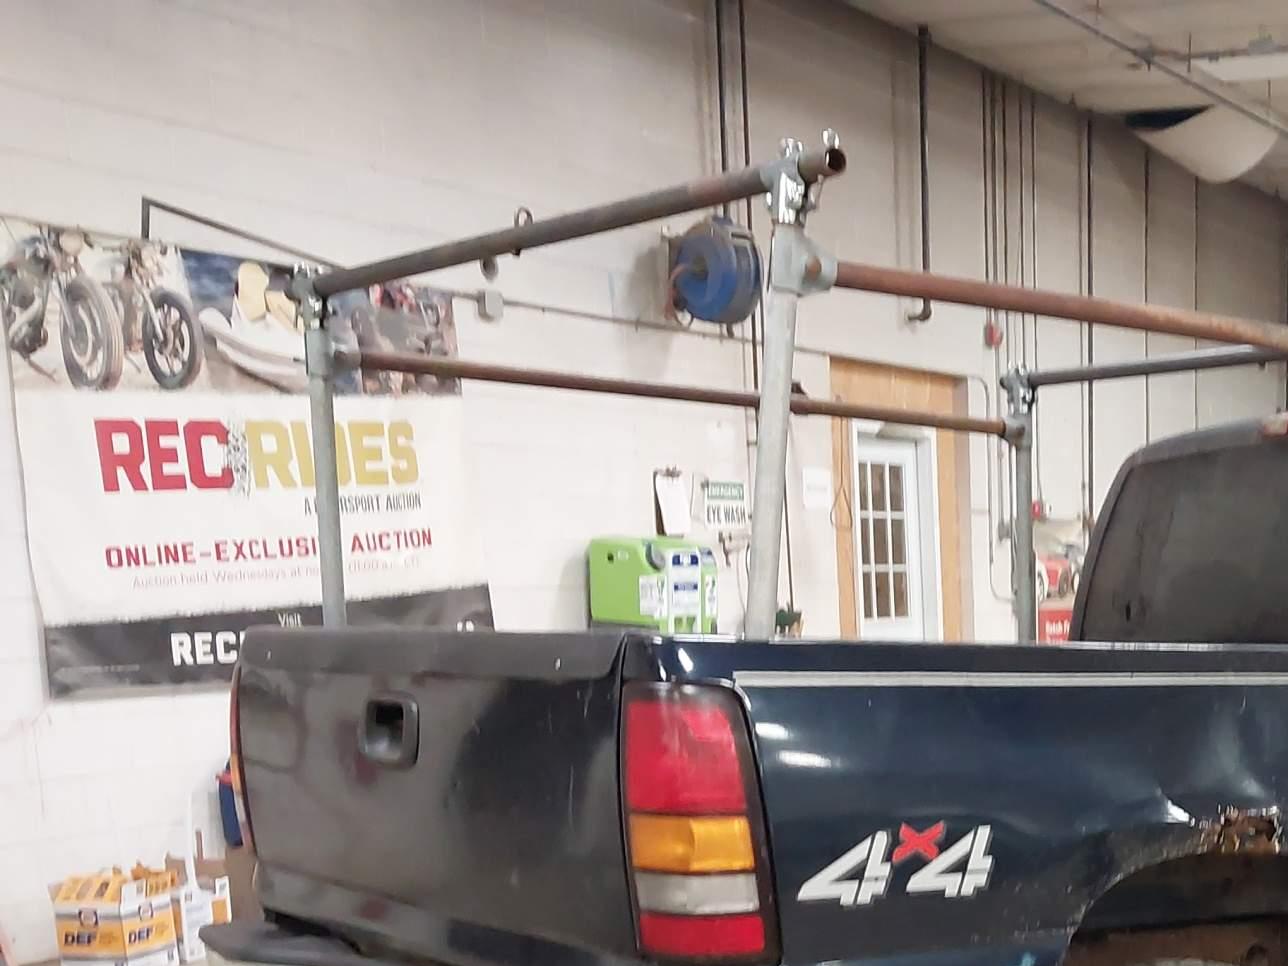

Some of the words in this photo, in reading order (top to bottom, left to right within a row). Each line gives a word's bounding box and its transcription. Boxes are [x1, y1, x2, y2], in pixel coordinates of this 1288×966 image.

[94, 419, 235, 492] REC
[708, 486, 743, 498] EMERGENCY
[304, 497, 312, 517] A
[385, 491, 422, 511] AUCTION
[706, 505, 721, 524] EYE
[723, 504, 746, 524] WASH
[105, 536, 317, 569] ONLINE-EXCLUSI
[351, 528, 433, 553] AUCTION
[132, 573, 177, 588] Auction
[180, 570, 208, 585] held
[212, 566, 287, 584] Wednesdays
[278, 612, 301, 628] Visit
